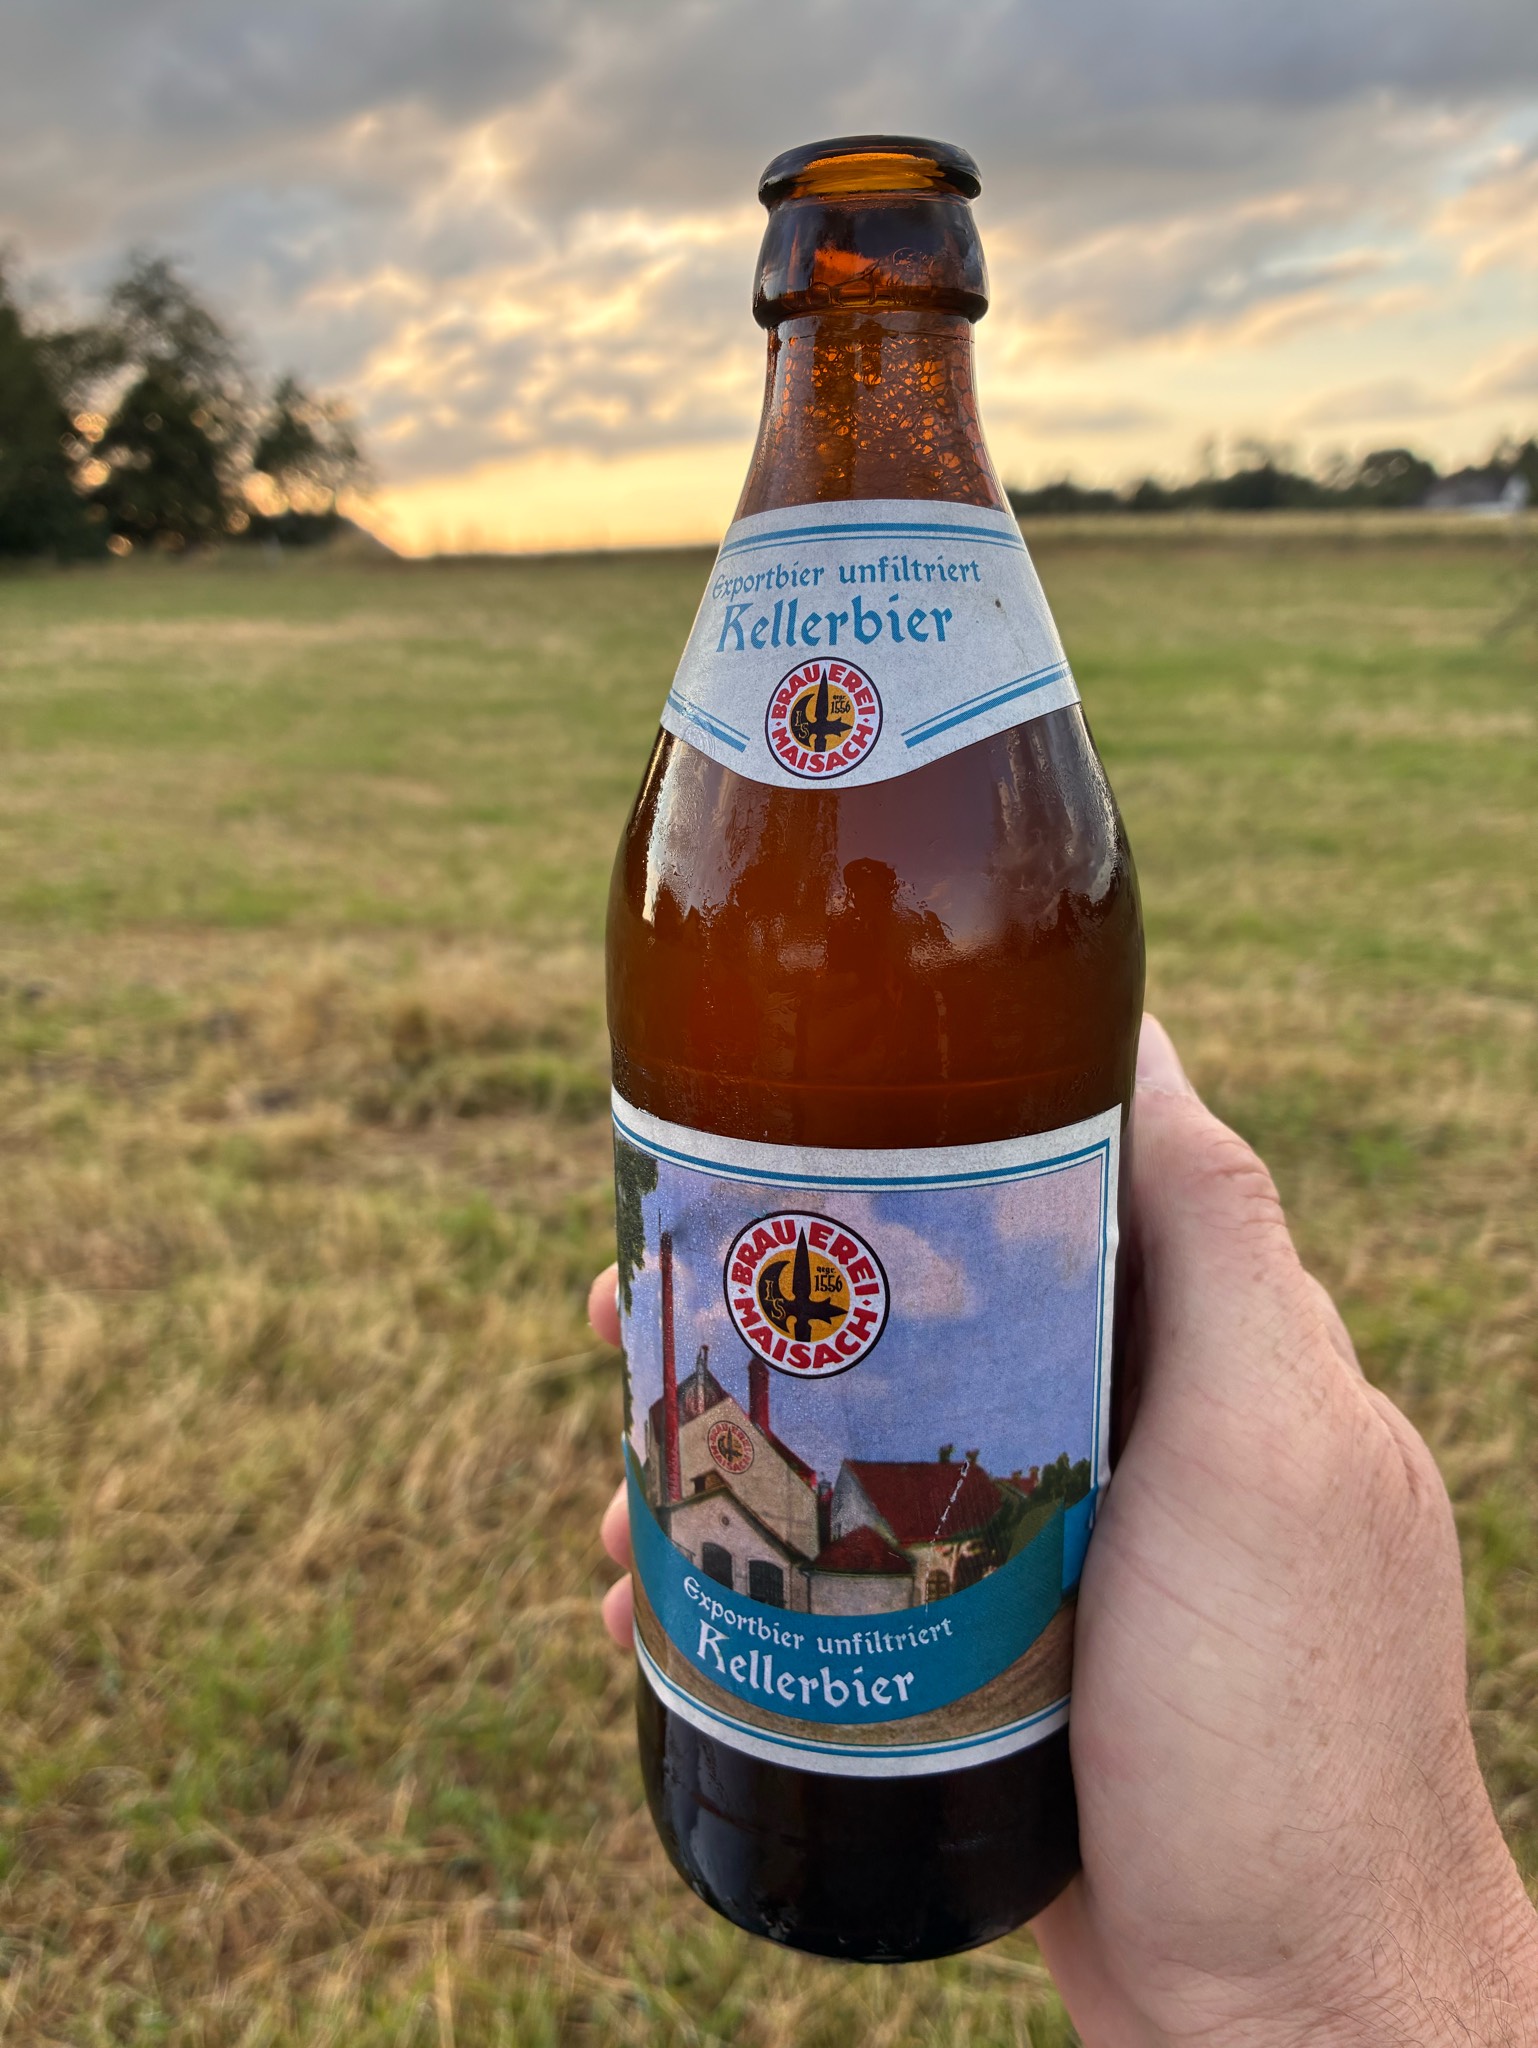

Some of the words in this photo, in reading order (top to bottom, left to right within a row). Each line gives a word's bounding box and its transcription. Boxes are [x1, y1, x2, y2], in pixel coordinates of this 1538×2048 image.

[711, 562, 825, 602] Exportbier
[838, 554, 982, 583] unfiltriert
[716, 593, 953, 653] Kellerbier
[830, 700, 851, 714] 1556
[771, 723, 874, 773] MAISACH
[814, 1274, 843, 1293] 1556
[733, 1297, 878, 1370] MAISACH
[683, 1576, 805, 1650] Exportbier
[816, 1617, 953, 1655] unfiltriert
[696, 1618, 914, 1708] Kellerbier
